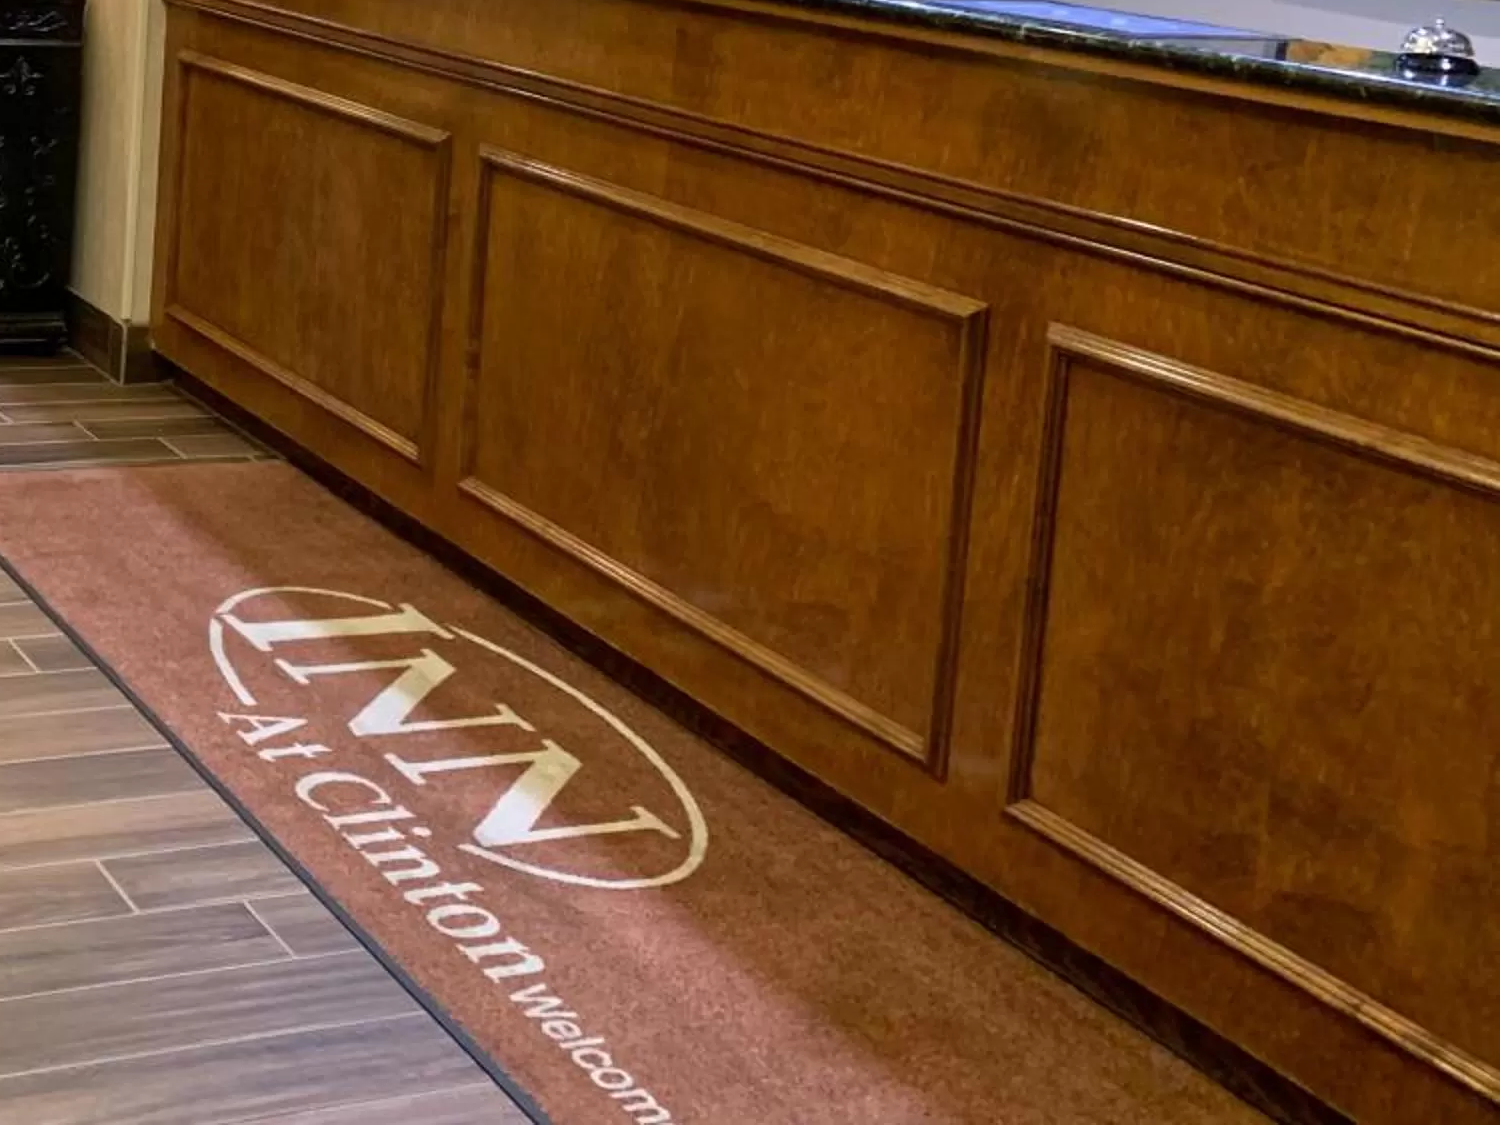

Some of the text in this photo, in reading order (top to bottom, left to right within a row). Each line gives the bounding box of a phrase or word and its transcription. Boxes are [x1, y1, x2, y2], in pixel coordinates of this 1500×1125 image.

[216, 709, 546, 984] At Clinton
[219, 602, 681, 848] INN
[510, 982, 673, 1125] Welcom
